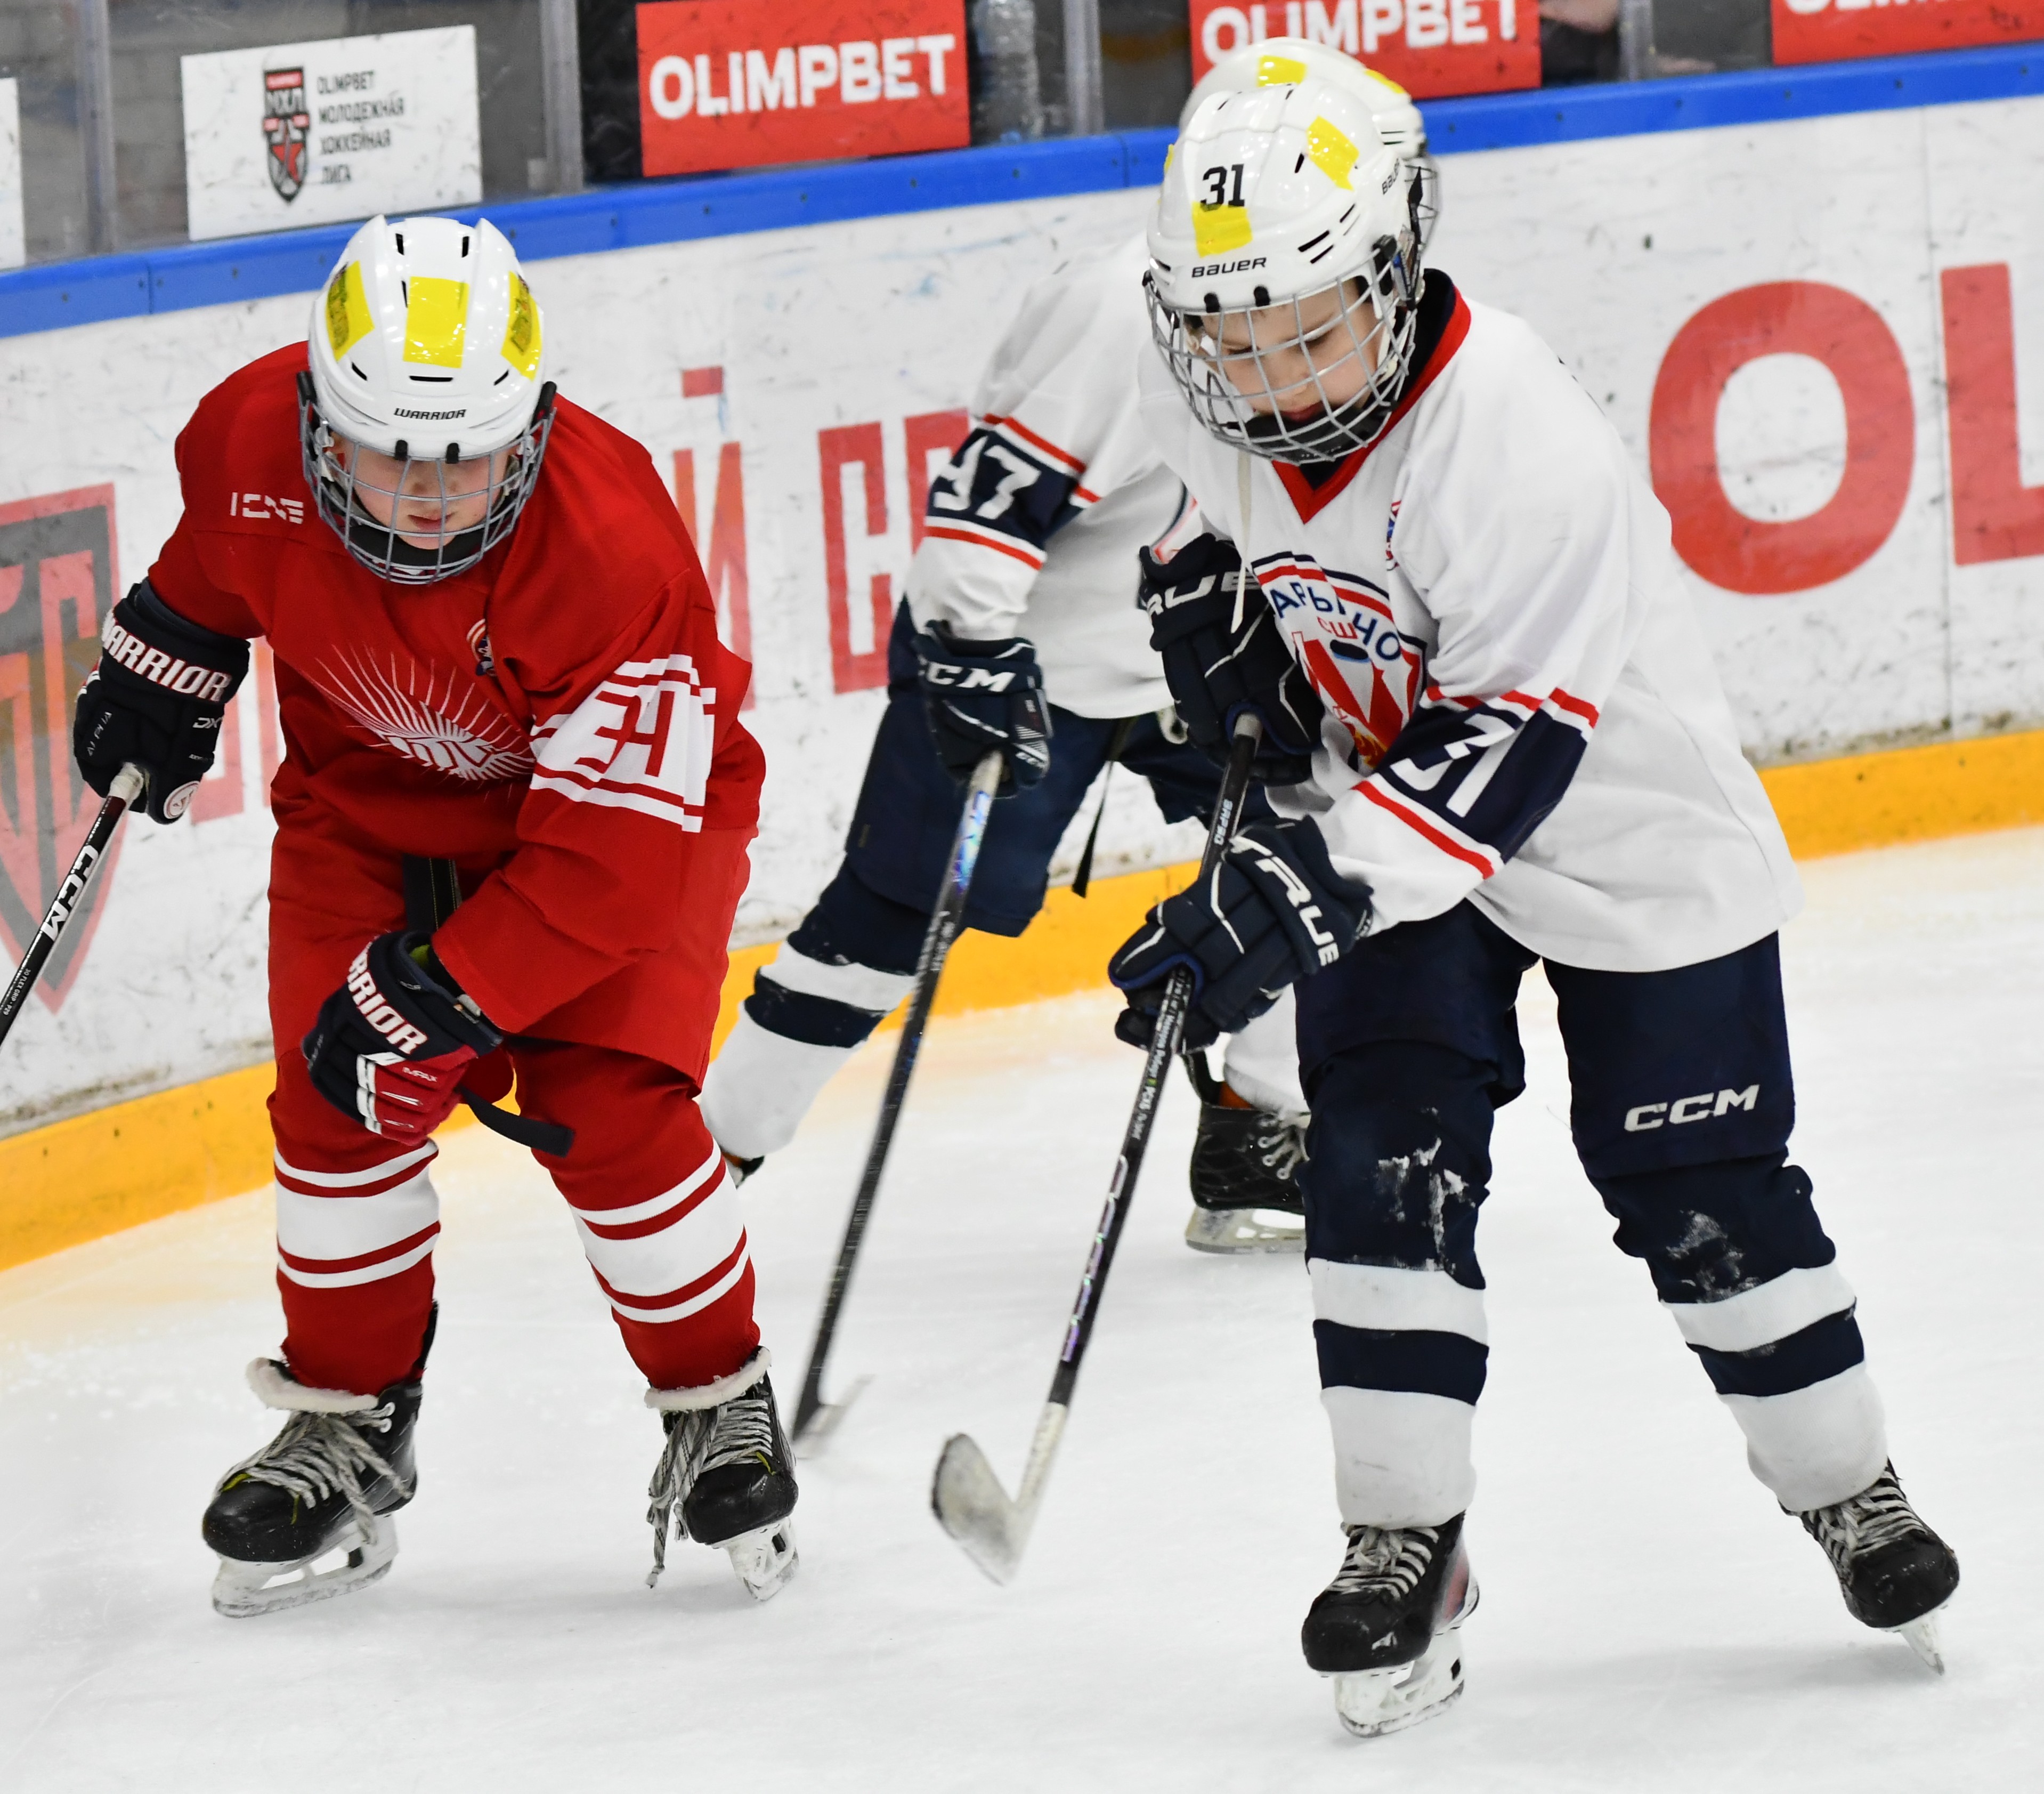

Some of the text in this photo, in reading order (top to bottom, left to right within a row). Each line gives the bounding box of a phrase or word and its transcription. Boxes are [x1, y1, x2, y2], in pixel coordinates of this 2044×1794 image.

[317, 70, 375, 95] OLIMPBET
[648, 33, 955, 120] OLIMPBET
[321, 164, 352, 184] ЛИГА
[1200, 163, 1245, 212] 31
[393, 407, 467, 421] WARRIOR
[1146, 571, 1261, 624] RUE
[101, 608, 233, 702] ARRIOR
[917, 653, 1016, 692] CM
[1389, 712, 1528, 819] 31
[40, 844, 99, 941] CCM
[1229, 835, 1340, 967] TRUE
[10, 989, 21, 1002] GRIP
[17, 975, 28, 990] FLEX
[347, 941, 428, 1055] RRIOR
[1624, 1084, 1760, 1132] CCM
